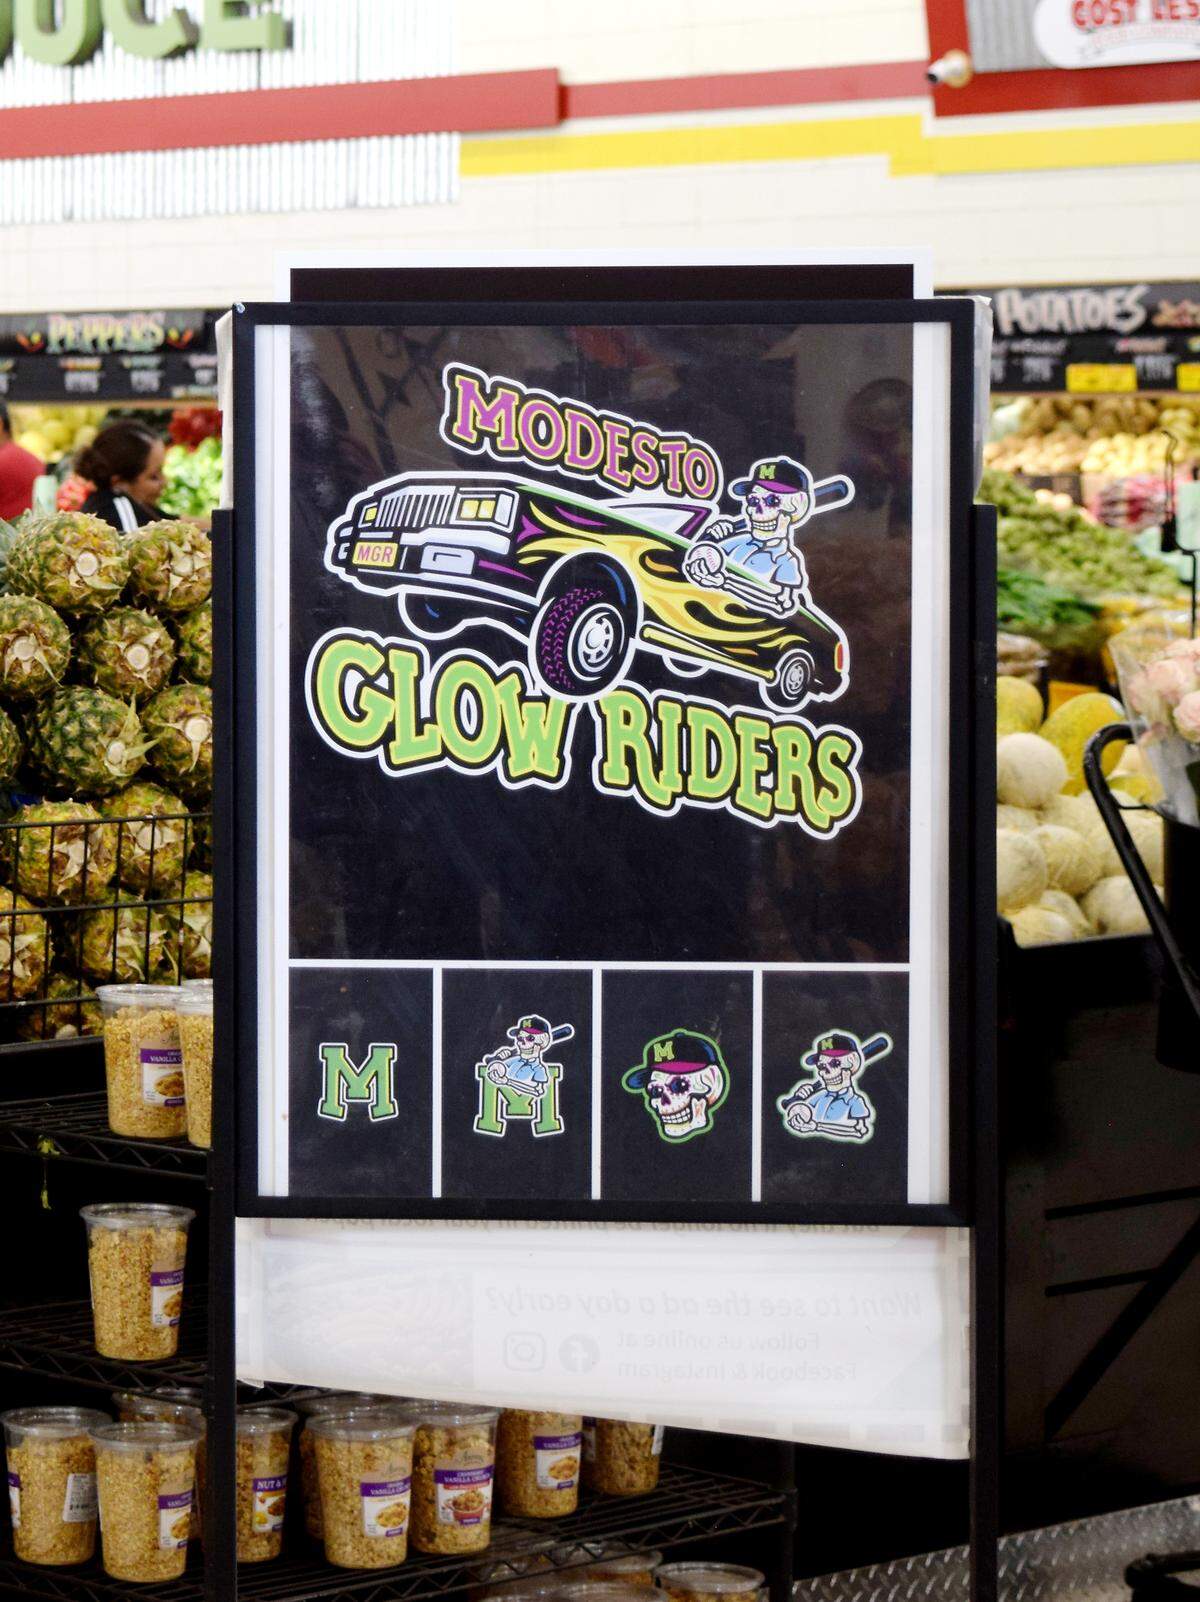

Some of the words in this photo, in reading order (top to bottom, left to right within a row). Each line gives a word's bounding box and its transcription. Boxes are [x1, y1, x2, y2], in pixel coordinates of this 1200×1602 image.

[996, 284, 1148, 335] POTATOES
[452, 374, 716, 499] MODESTO
[357, 544, 394, 563] MGR
[316, 637, 577, 779] GLOW
[602, 691, 856, 830] RIDERS
[653, 1040, 675, 1062] M
[320, 1045, 396, 1120] M
[257, 1480, 274, 1490] NUT
